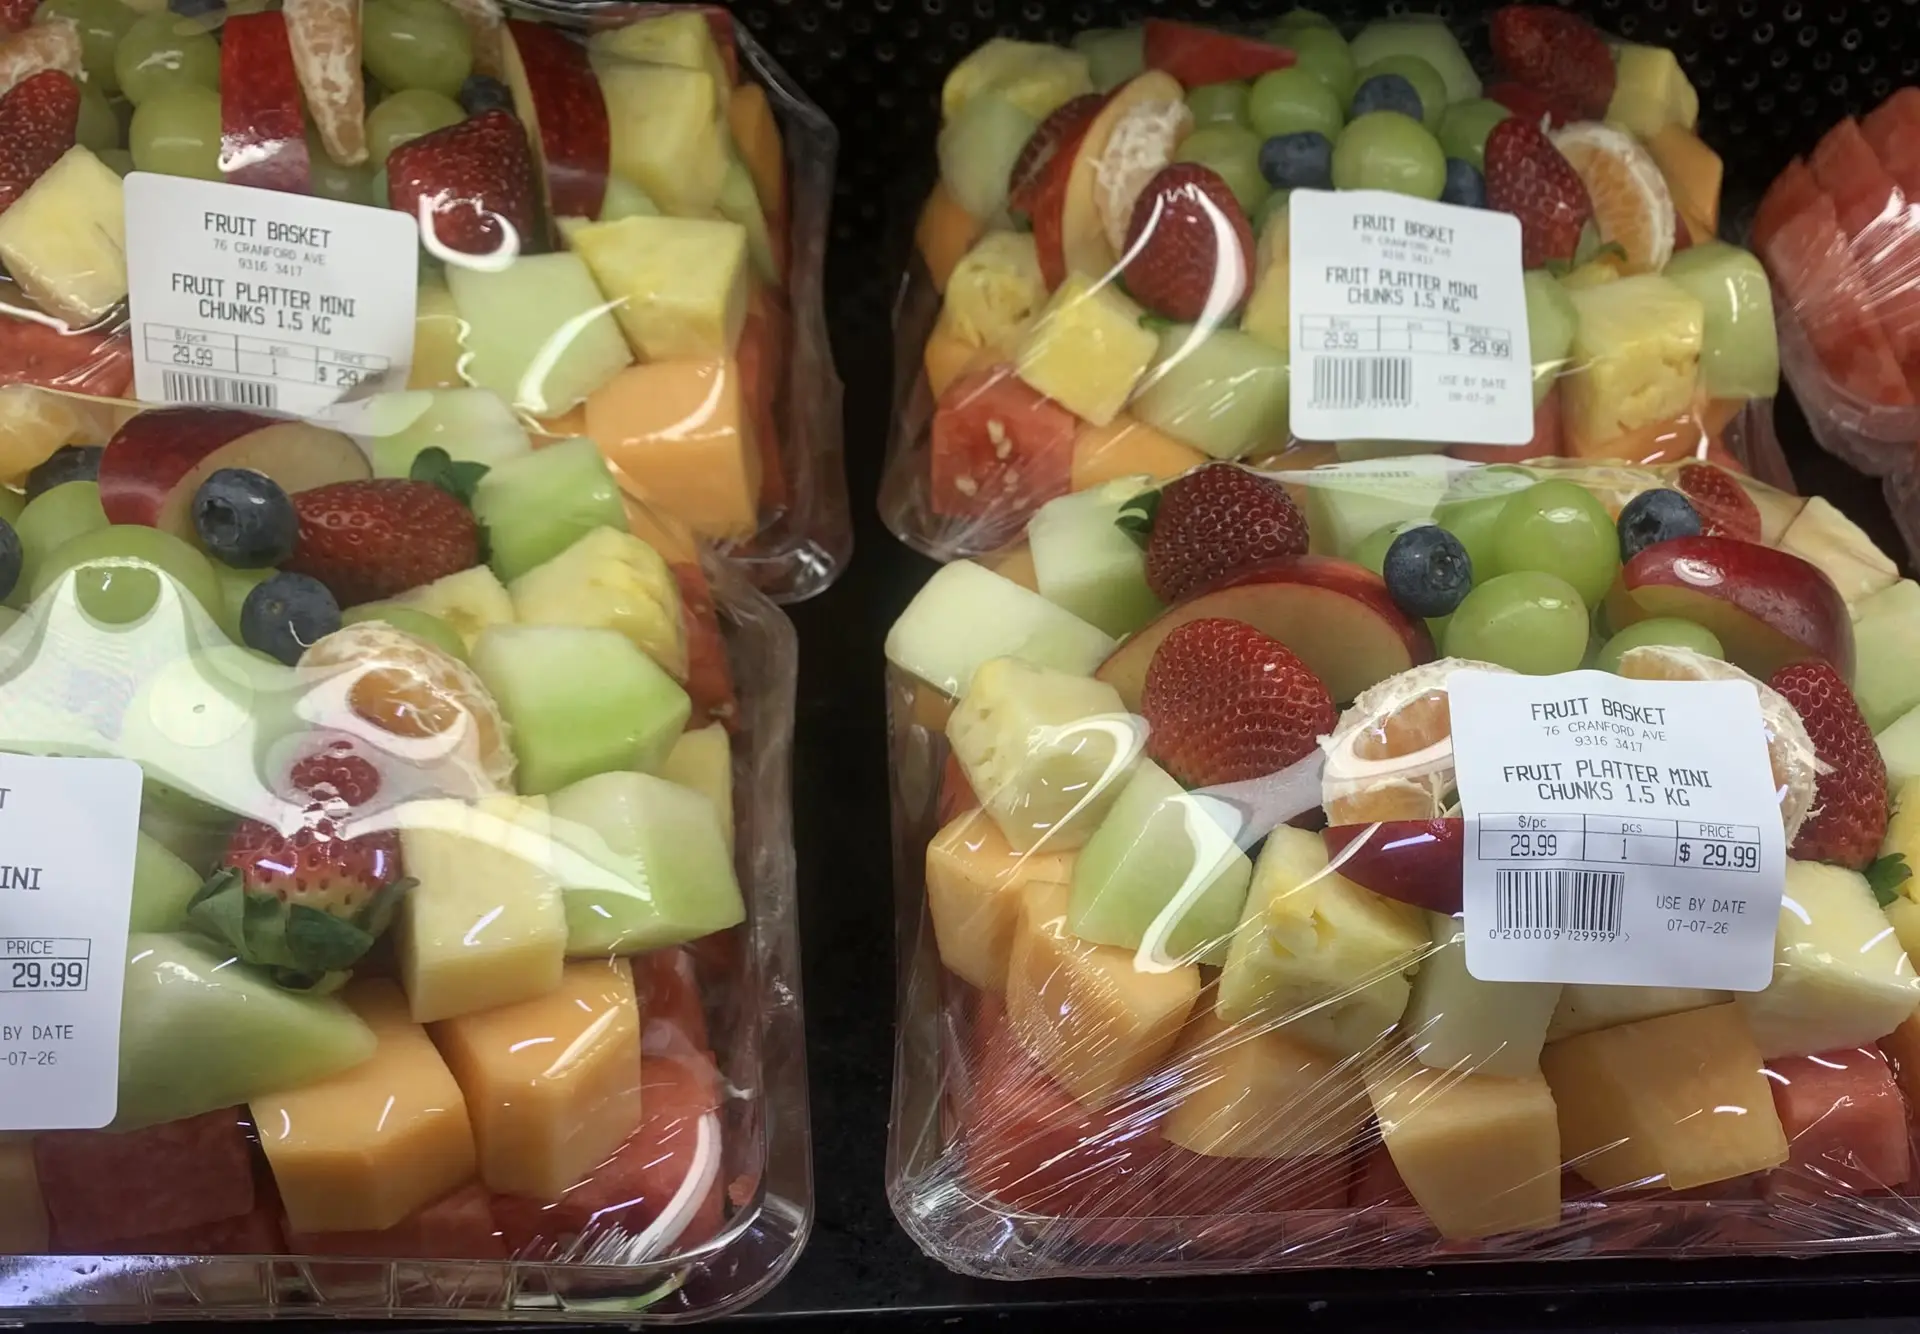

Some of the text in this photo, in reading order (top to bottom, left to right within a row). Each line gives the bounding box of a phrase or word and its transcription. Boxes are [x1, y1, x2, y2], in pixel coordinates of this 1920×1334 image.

[204, 212, 332, 248] FRUIT BASKET
[1353, 214, 1455, 244] FRUIT BASKET
[214, 239, 327, 266] 76 CRANFORD AVE
[238, 258, 303, 277] 9316 3417
[1326, 266, 1479, 300] FRUIT PLATTER MINI
[172, 273, 356, 317] FRUIT PLATTER MINI
[1348, 287, 1461, 314] CHUNKS 1.5 KG
[199, 299, 265, 325] CHUNKS
[277, 310, 303, 331] 1.5
[1323, 331, 1359, 350] 29.99
[1469, 338, 1510, 358] 29.99
[173, 344, 213, 367] 29.99
[271, 358, 278, 376] 1
[1481, 377, 1507, 390] DATE
[1531, 698, 1666, 726] FRUIT BASKET
[1543, 720, 1667, 743] 76 CRANFORD AVE
[1575, 735, 1643, 753] 9316 3417
[1503, 759, 1713, 789] FRUIT PLATTER MINI
[1538, 781, 1690, 807] CHUNKS 1.5 KG
[1518, 815, 1547, 831] $/pc
[1621, 823, 1643, 836] pcs
[1699, 825, 1735, 840] PRICE
[1510, 834, 1557, 857] 29.99
[1621, 838, 1628, 860] 1
[1678, 842, 1757, 868] $ 29.99
[1656, 895, 1746, 914] USE BY DATE
[1667, 919, 1729, 935] 07-07-26
[6, 940, 54, 955] PRICE
[12, 962, 83, 988] 29.99
[3, 1024, 75, 1040] BY DATE
